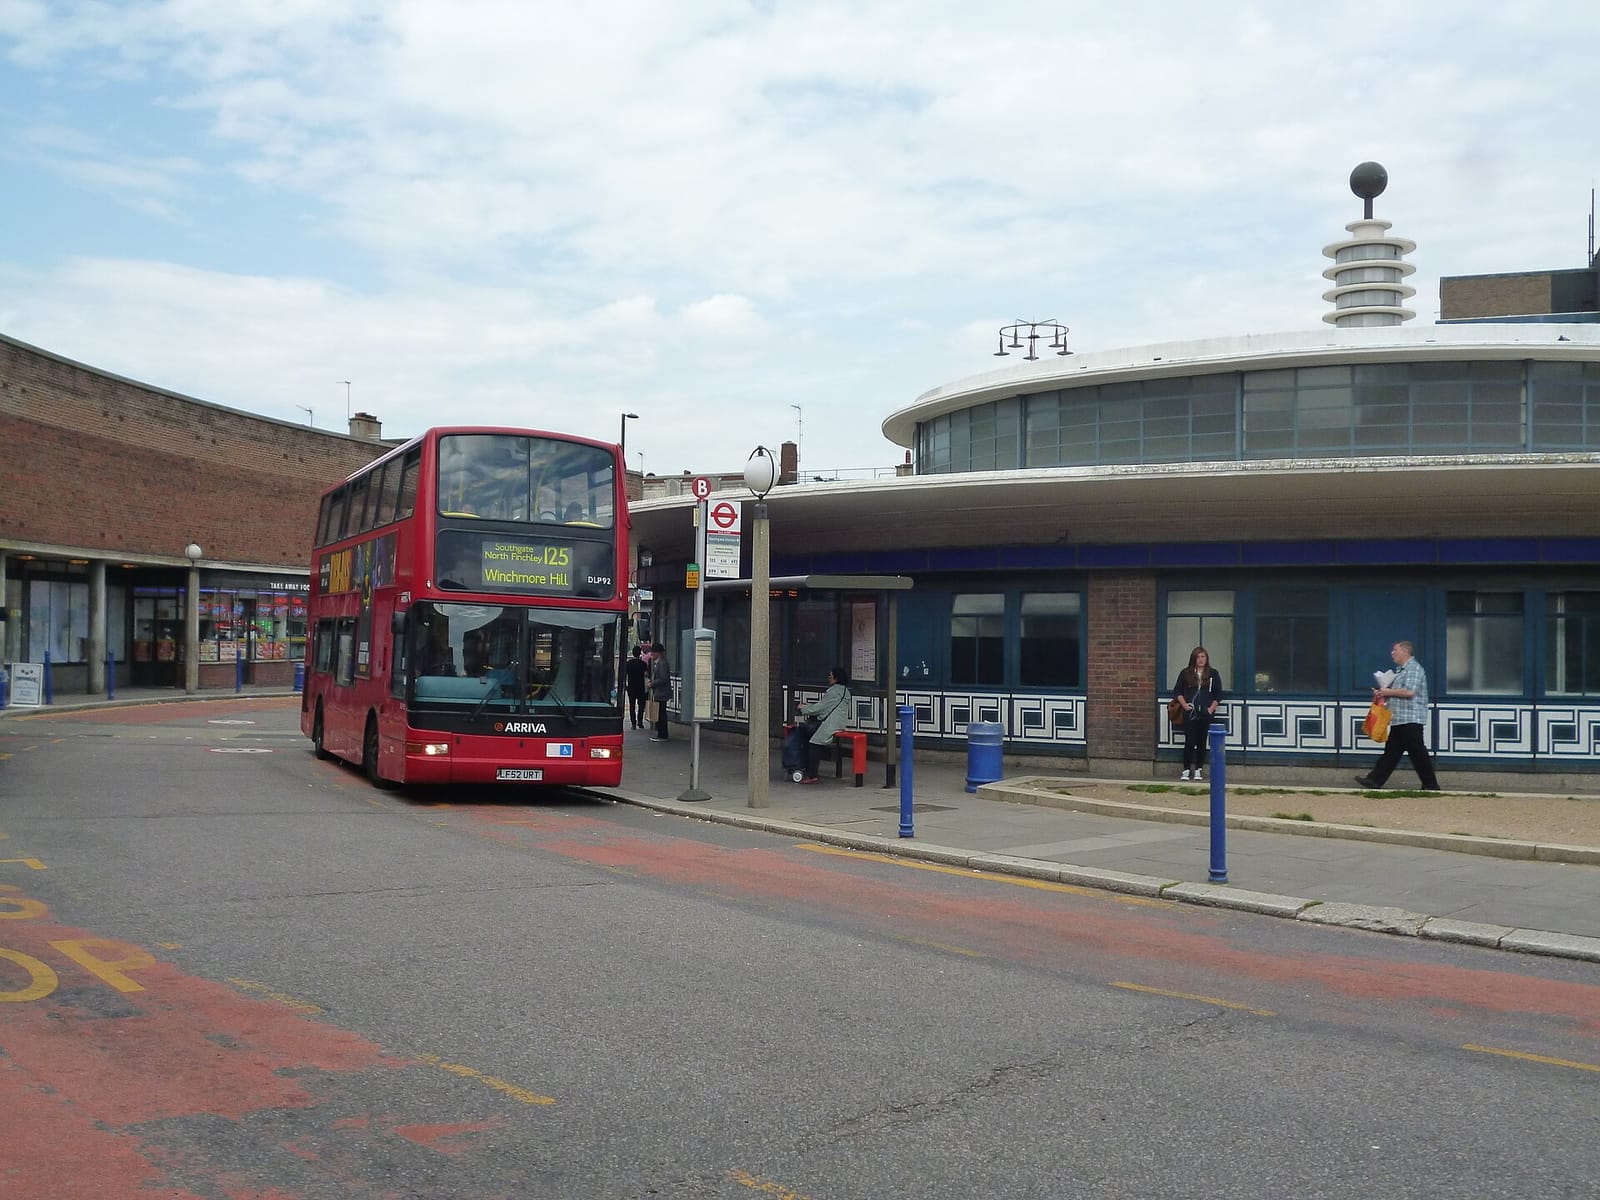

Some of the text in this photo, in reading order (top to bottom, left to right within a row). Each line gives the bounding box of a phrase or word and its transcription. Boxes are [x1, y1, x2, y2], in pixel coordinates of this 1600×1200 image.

[697, 480, 708, 496] B
[495, 543, 534, 554] Southgate
[484, 551, 543, 565] North Finchley
[543, 546, 569, 566] 125
[484, 568, 568, 586] Winchmore Hill
[270, 582, 284, 590] TAKE
[504, 722, 547, 733] ARRIVA
[523, 769, 540, 779] URT
